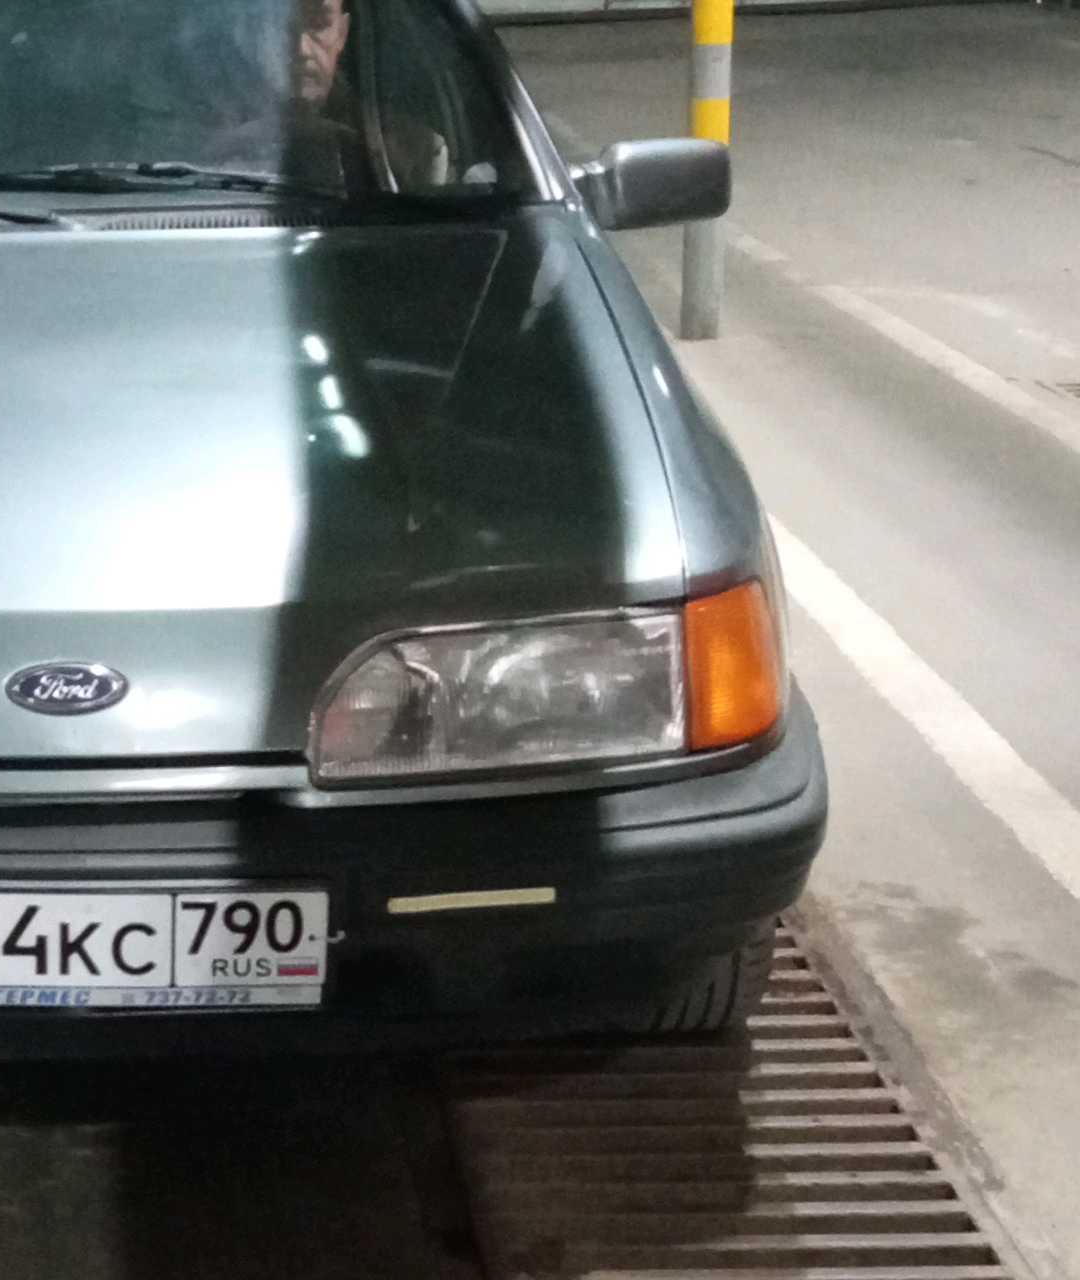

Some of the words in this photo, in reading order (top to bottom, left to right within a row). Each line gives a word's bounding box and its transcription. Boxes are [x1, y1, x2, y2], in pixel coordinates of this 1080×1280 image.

[34, 673, 99, 699] Ford
[180, 899, 303, 956] 790
[211, 957, 273, 978] RUS
